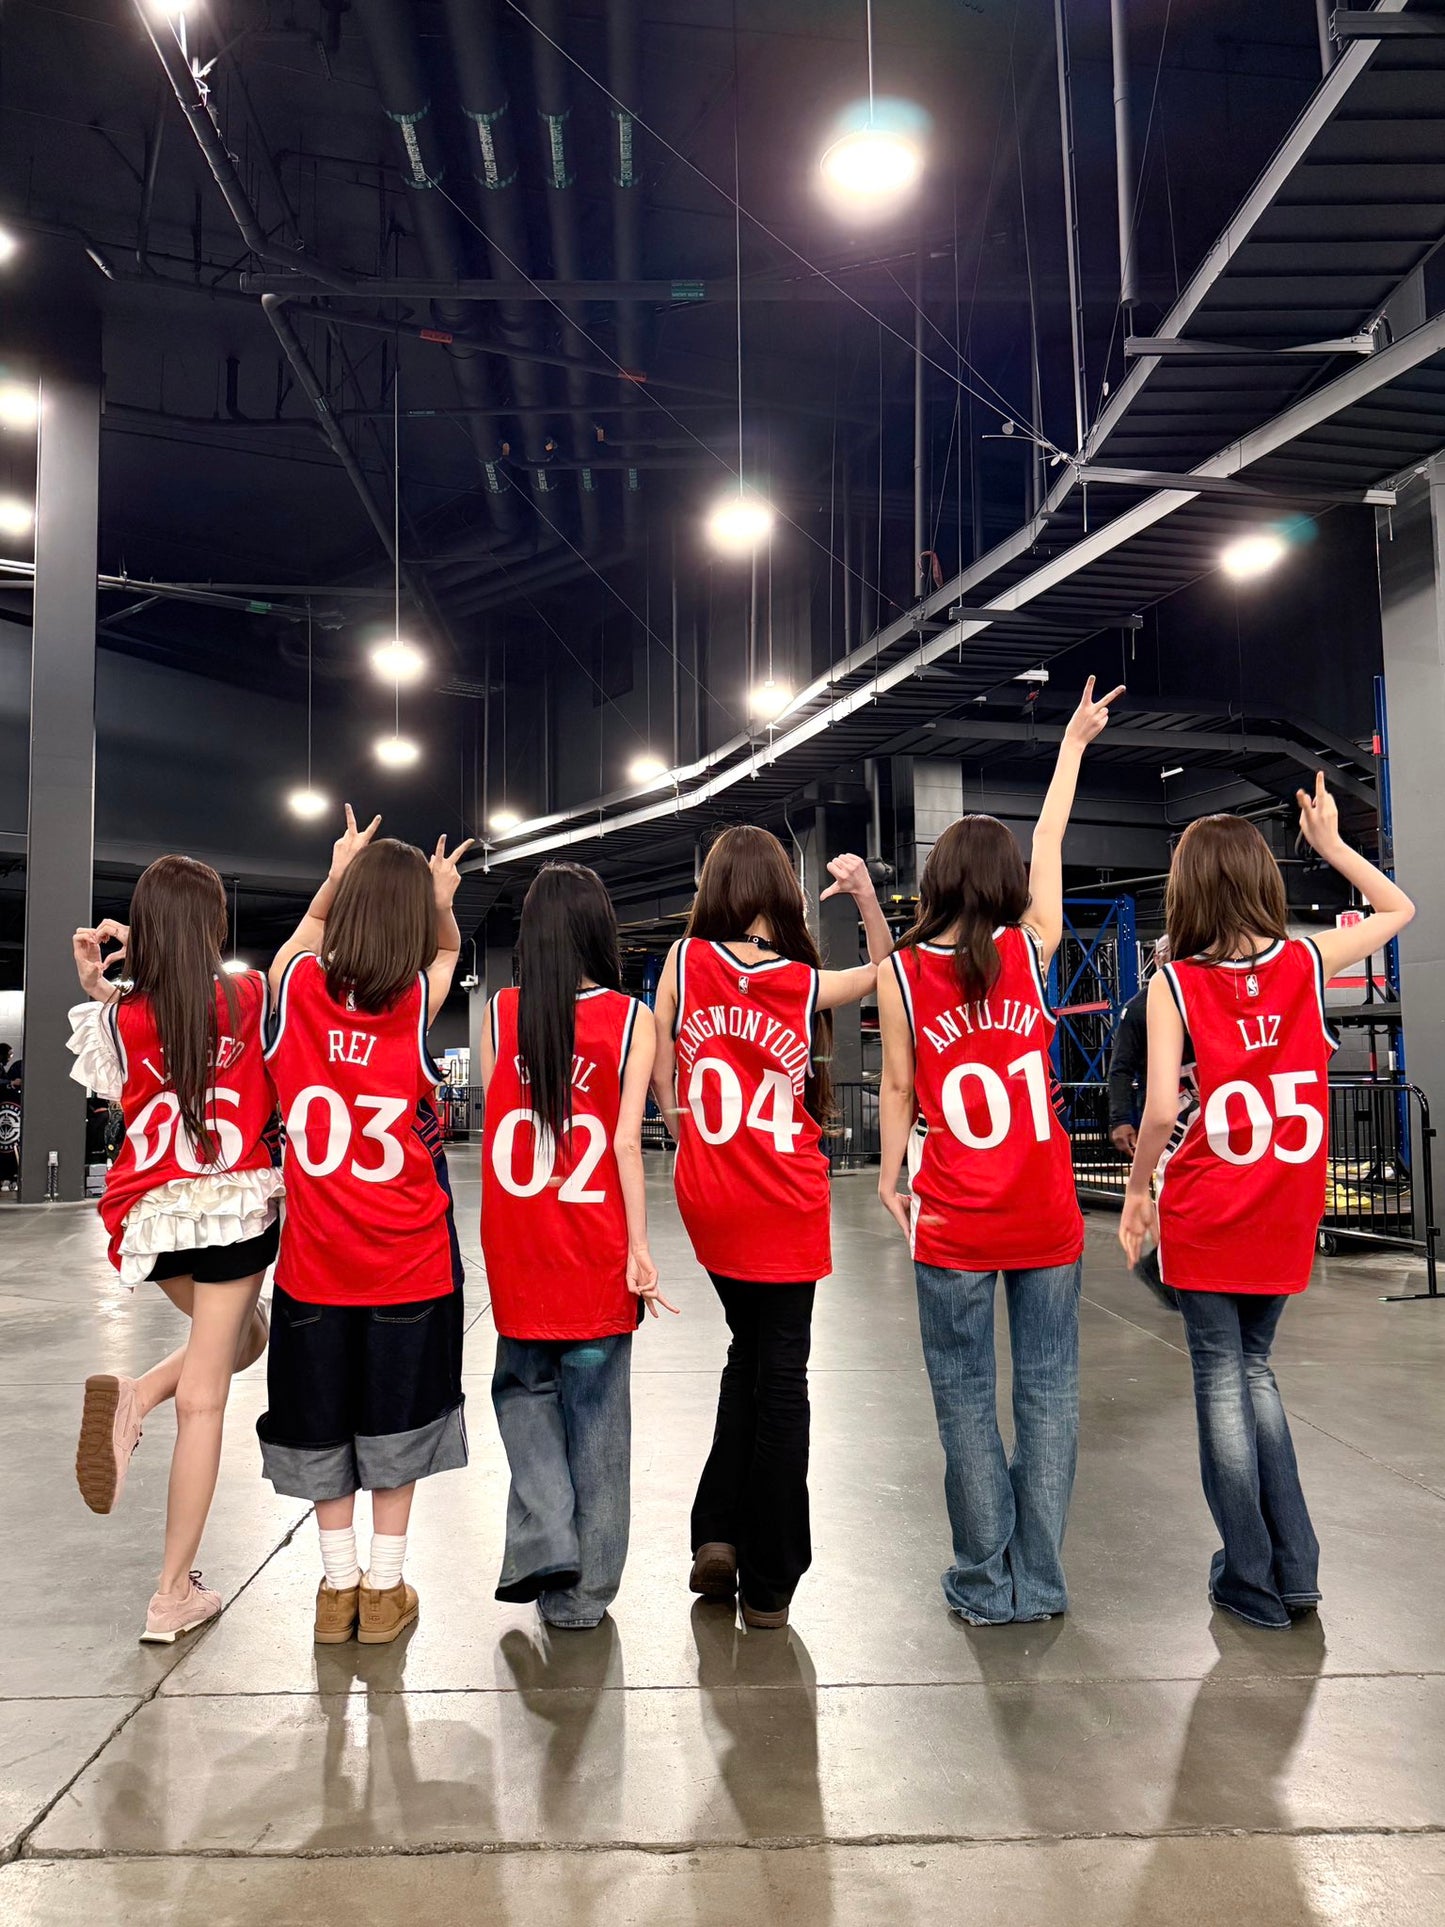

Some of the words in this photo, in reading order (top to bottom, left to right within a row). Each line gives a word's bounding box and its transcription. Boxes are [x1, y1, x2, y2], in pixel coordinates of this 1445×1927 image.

[328, 1029, 377, 1066] REI
[922, 999, 1040, 1054] ANYUJIN
[1236, 1015, 1281, 1051] LIZ
[126, 1087, 243, 1175] 06
[286, 1085, 408, 1183] 03
[687, 1057, 804, 1153] 04
[941, 1050, 1051, 1150] 01
[1204, 1070, 1324, 1165] 05
[491, 1108, 607, 1203] 02
